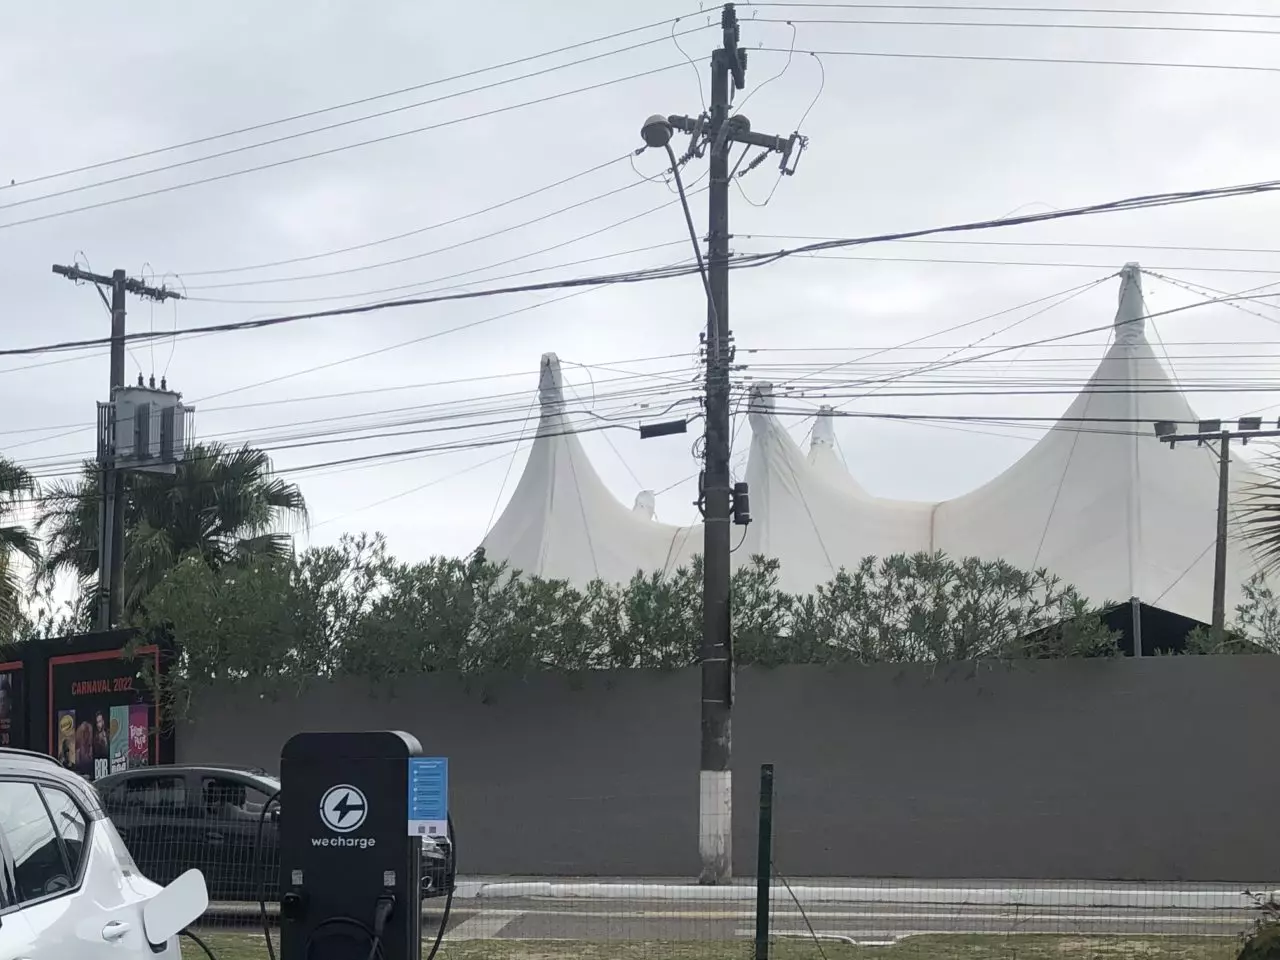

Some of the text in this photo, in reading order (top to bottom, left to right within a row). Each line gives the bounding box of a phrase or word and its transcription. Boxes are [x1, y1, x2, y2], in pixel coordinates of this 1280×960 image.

[72, 677, 133, 695] CARNAVAL 2022
[311, 836, 376, 849] wecharge
